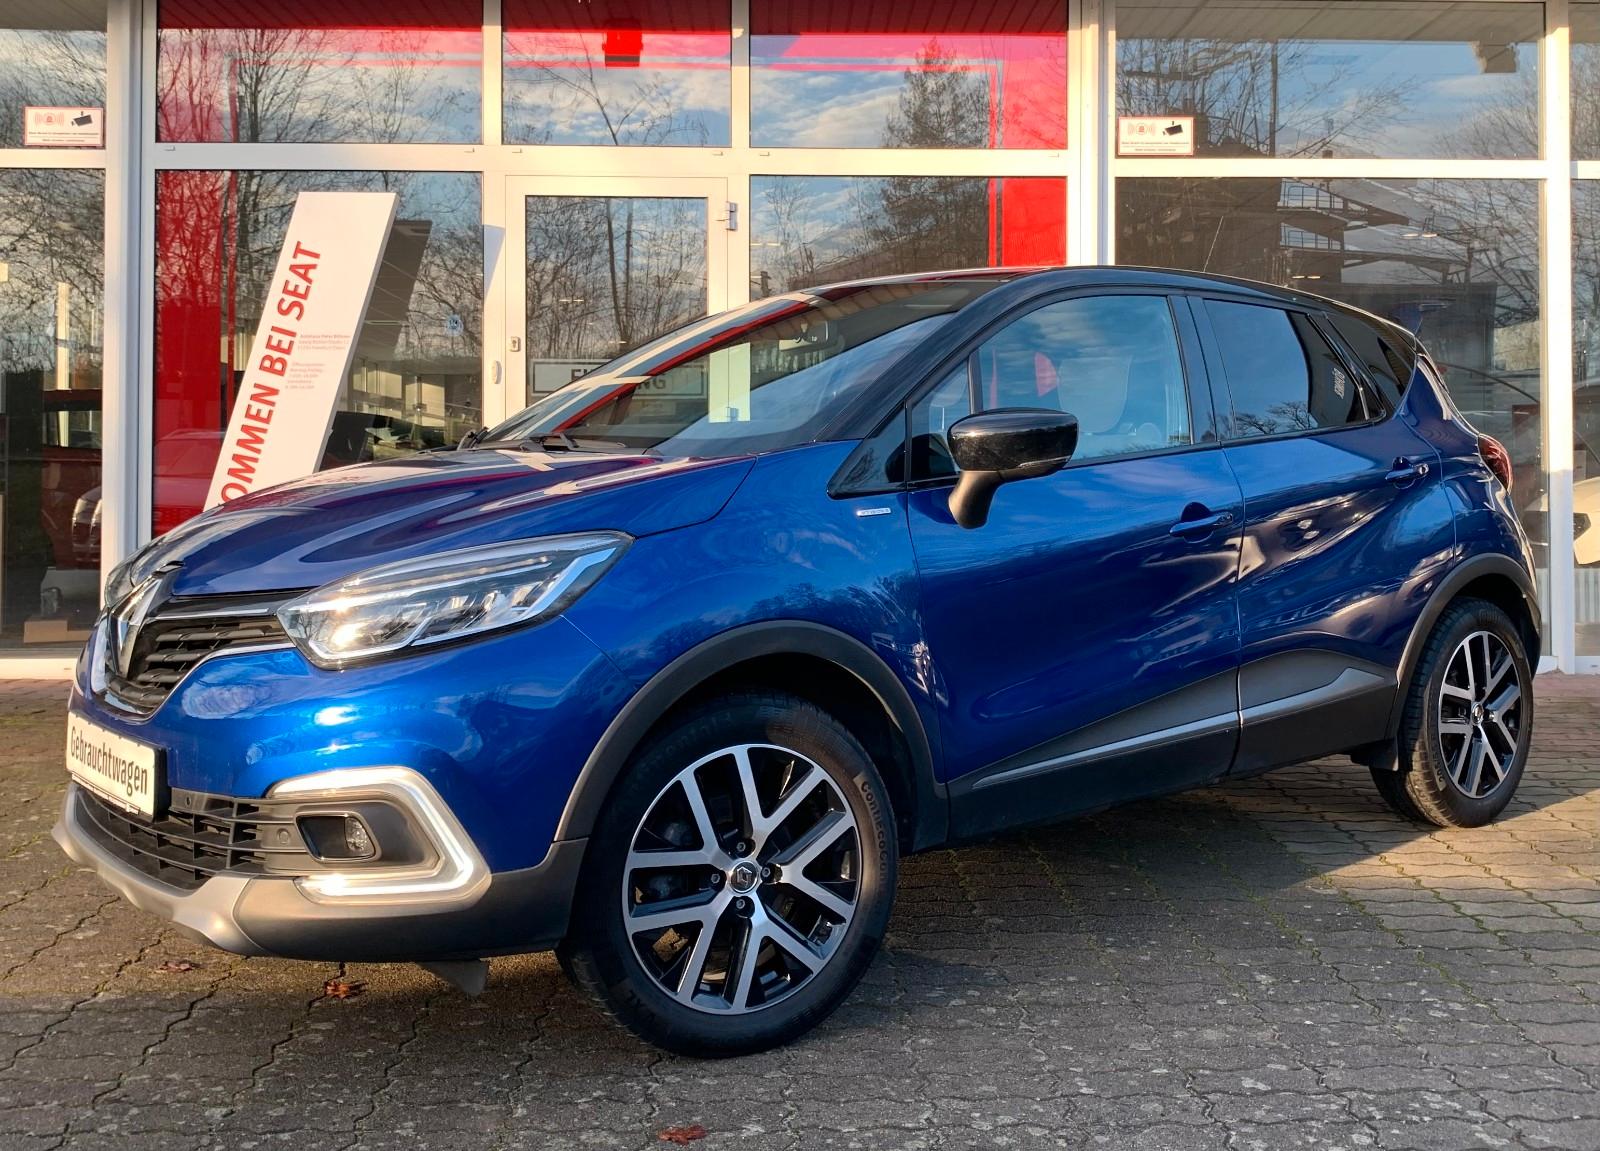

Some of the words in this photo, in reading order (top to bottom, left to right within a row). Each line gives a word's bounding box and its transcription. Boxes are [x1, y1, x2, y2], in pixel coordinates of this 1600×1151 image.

[276, 240, 321, 321] SEAT
[258, 325, 297, 376] BEI
[219, 383, 280, 504] OMMEN
[70, 725, 149, 798] Gebrauchtwagen
